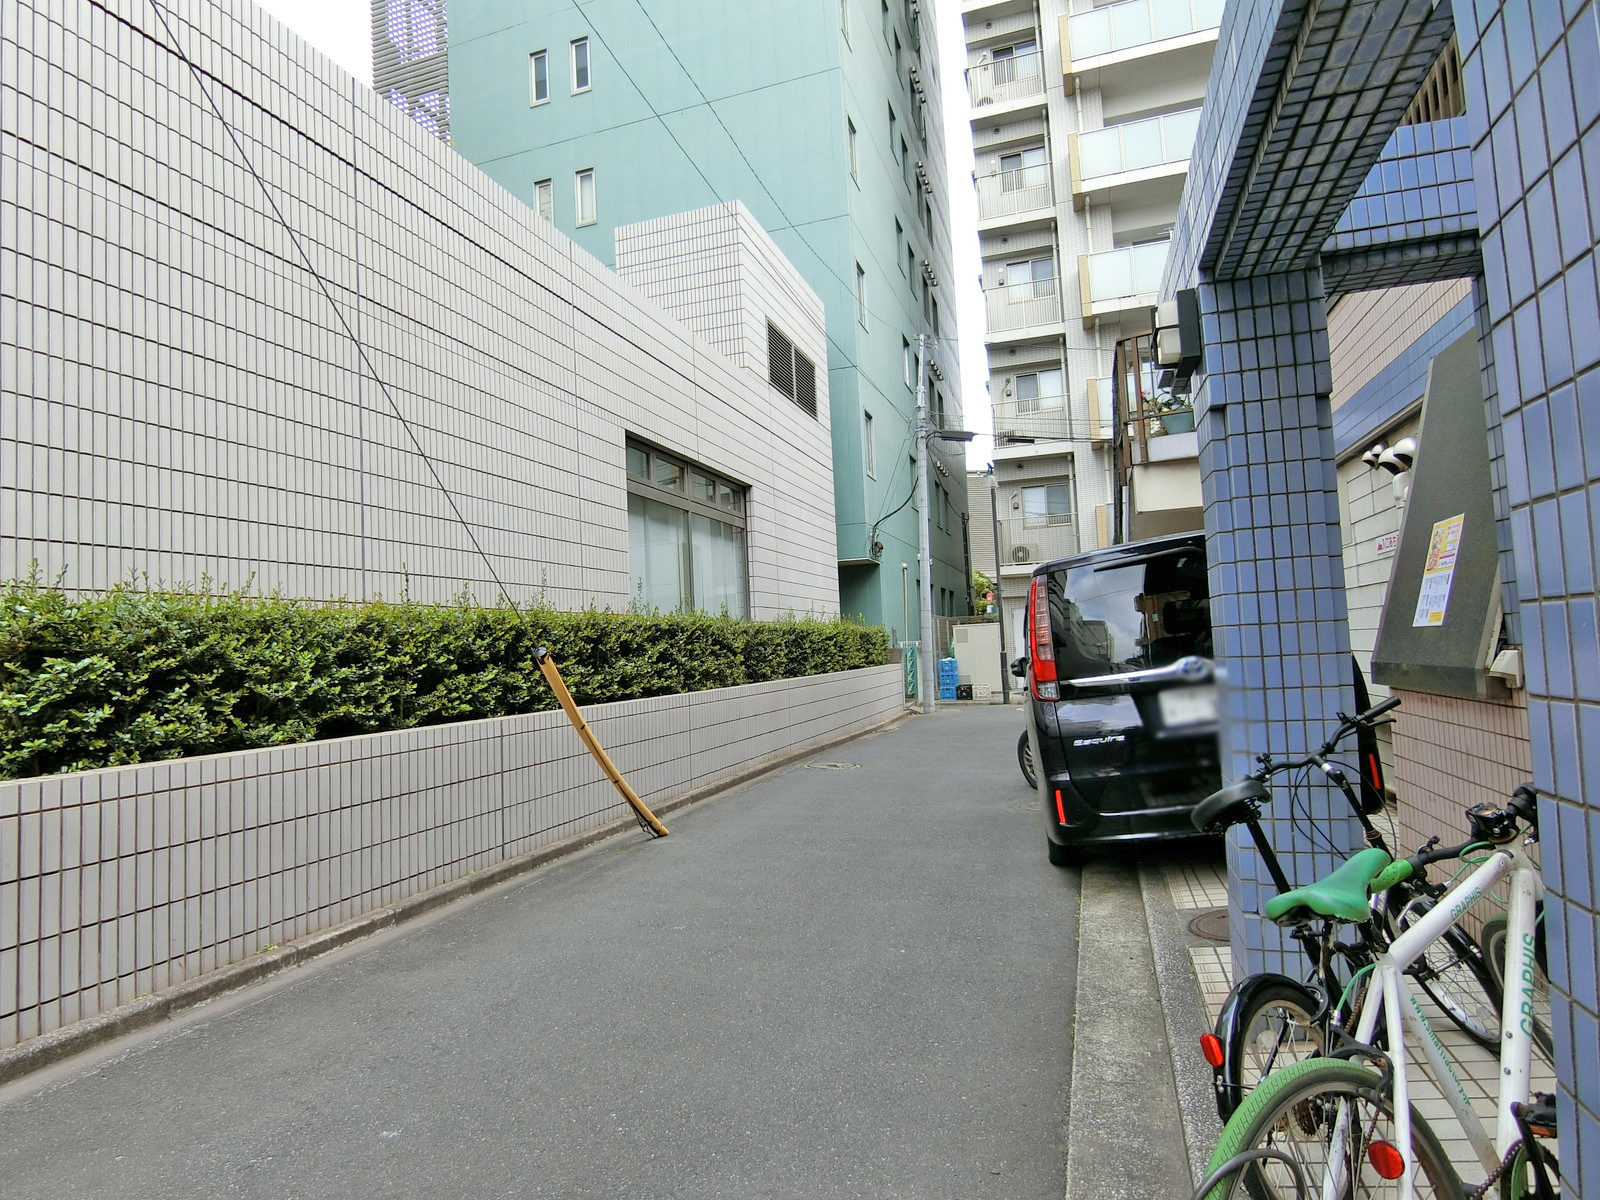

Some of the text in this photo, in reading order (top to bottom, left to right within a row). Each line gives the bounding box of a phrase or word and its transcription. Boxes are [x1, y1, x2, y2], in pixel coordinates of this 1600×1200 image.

[1073, 735, 1125, 747] Esquire
[1450, 887, 1481, 921] GRAPHIS
[1520, 932, 1535, 1037] GRAPHIS
